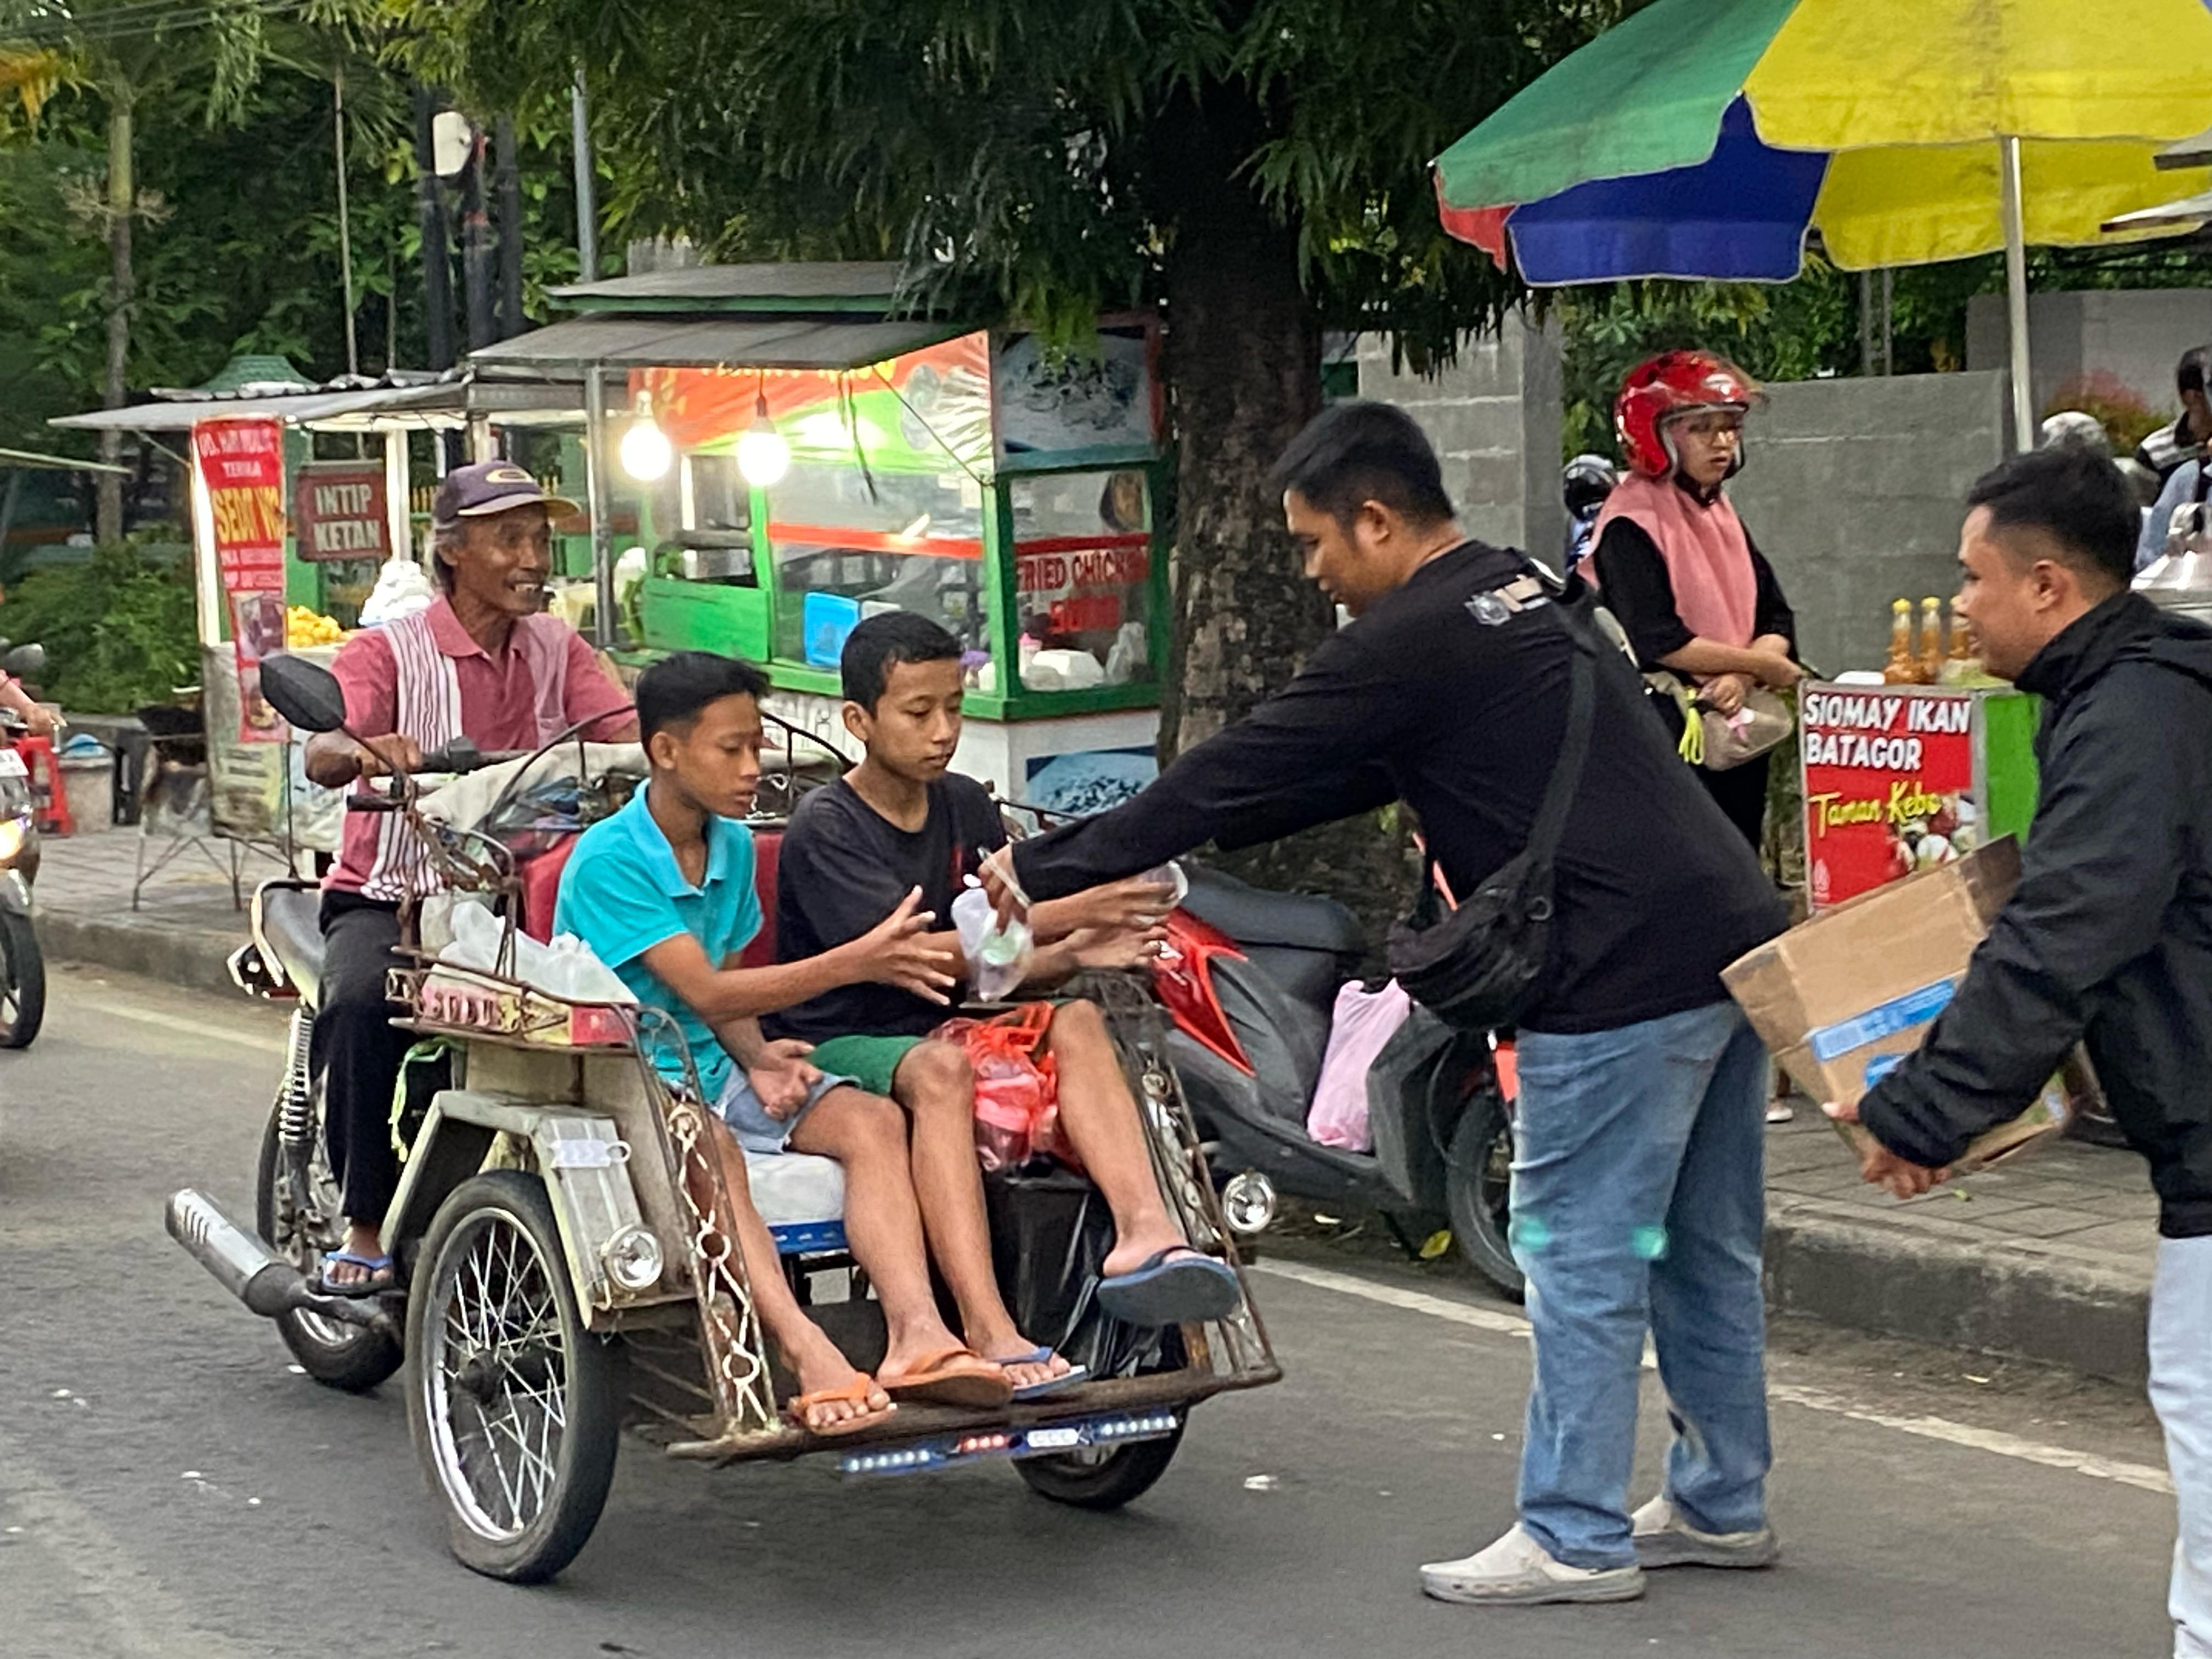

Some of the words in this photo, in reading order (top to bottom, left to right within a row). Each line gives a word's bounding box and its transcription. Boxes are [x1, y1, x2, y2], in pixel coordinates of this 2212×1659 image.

[314, 484, 373, 516] INTIP
[313, 520, 381, 552] KETAN
[1017, 556, 1066, 591] FRIED
[1804, 693, 1903, 731] SIOMAY
[1907, 698, 1972, 733] IKAN
[1805, 732, 1923, 771] BATAGOR
[1808, 792, 1882, 838] Taman
